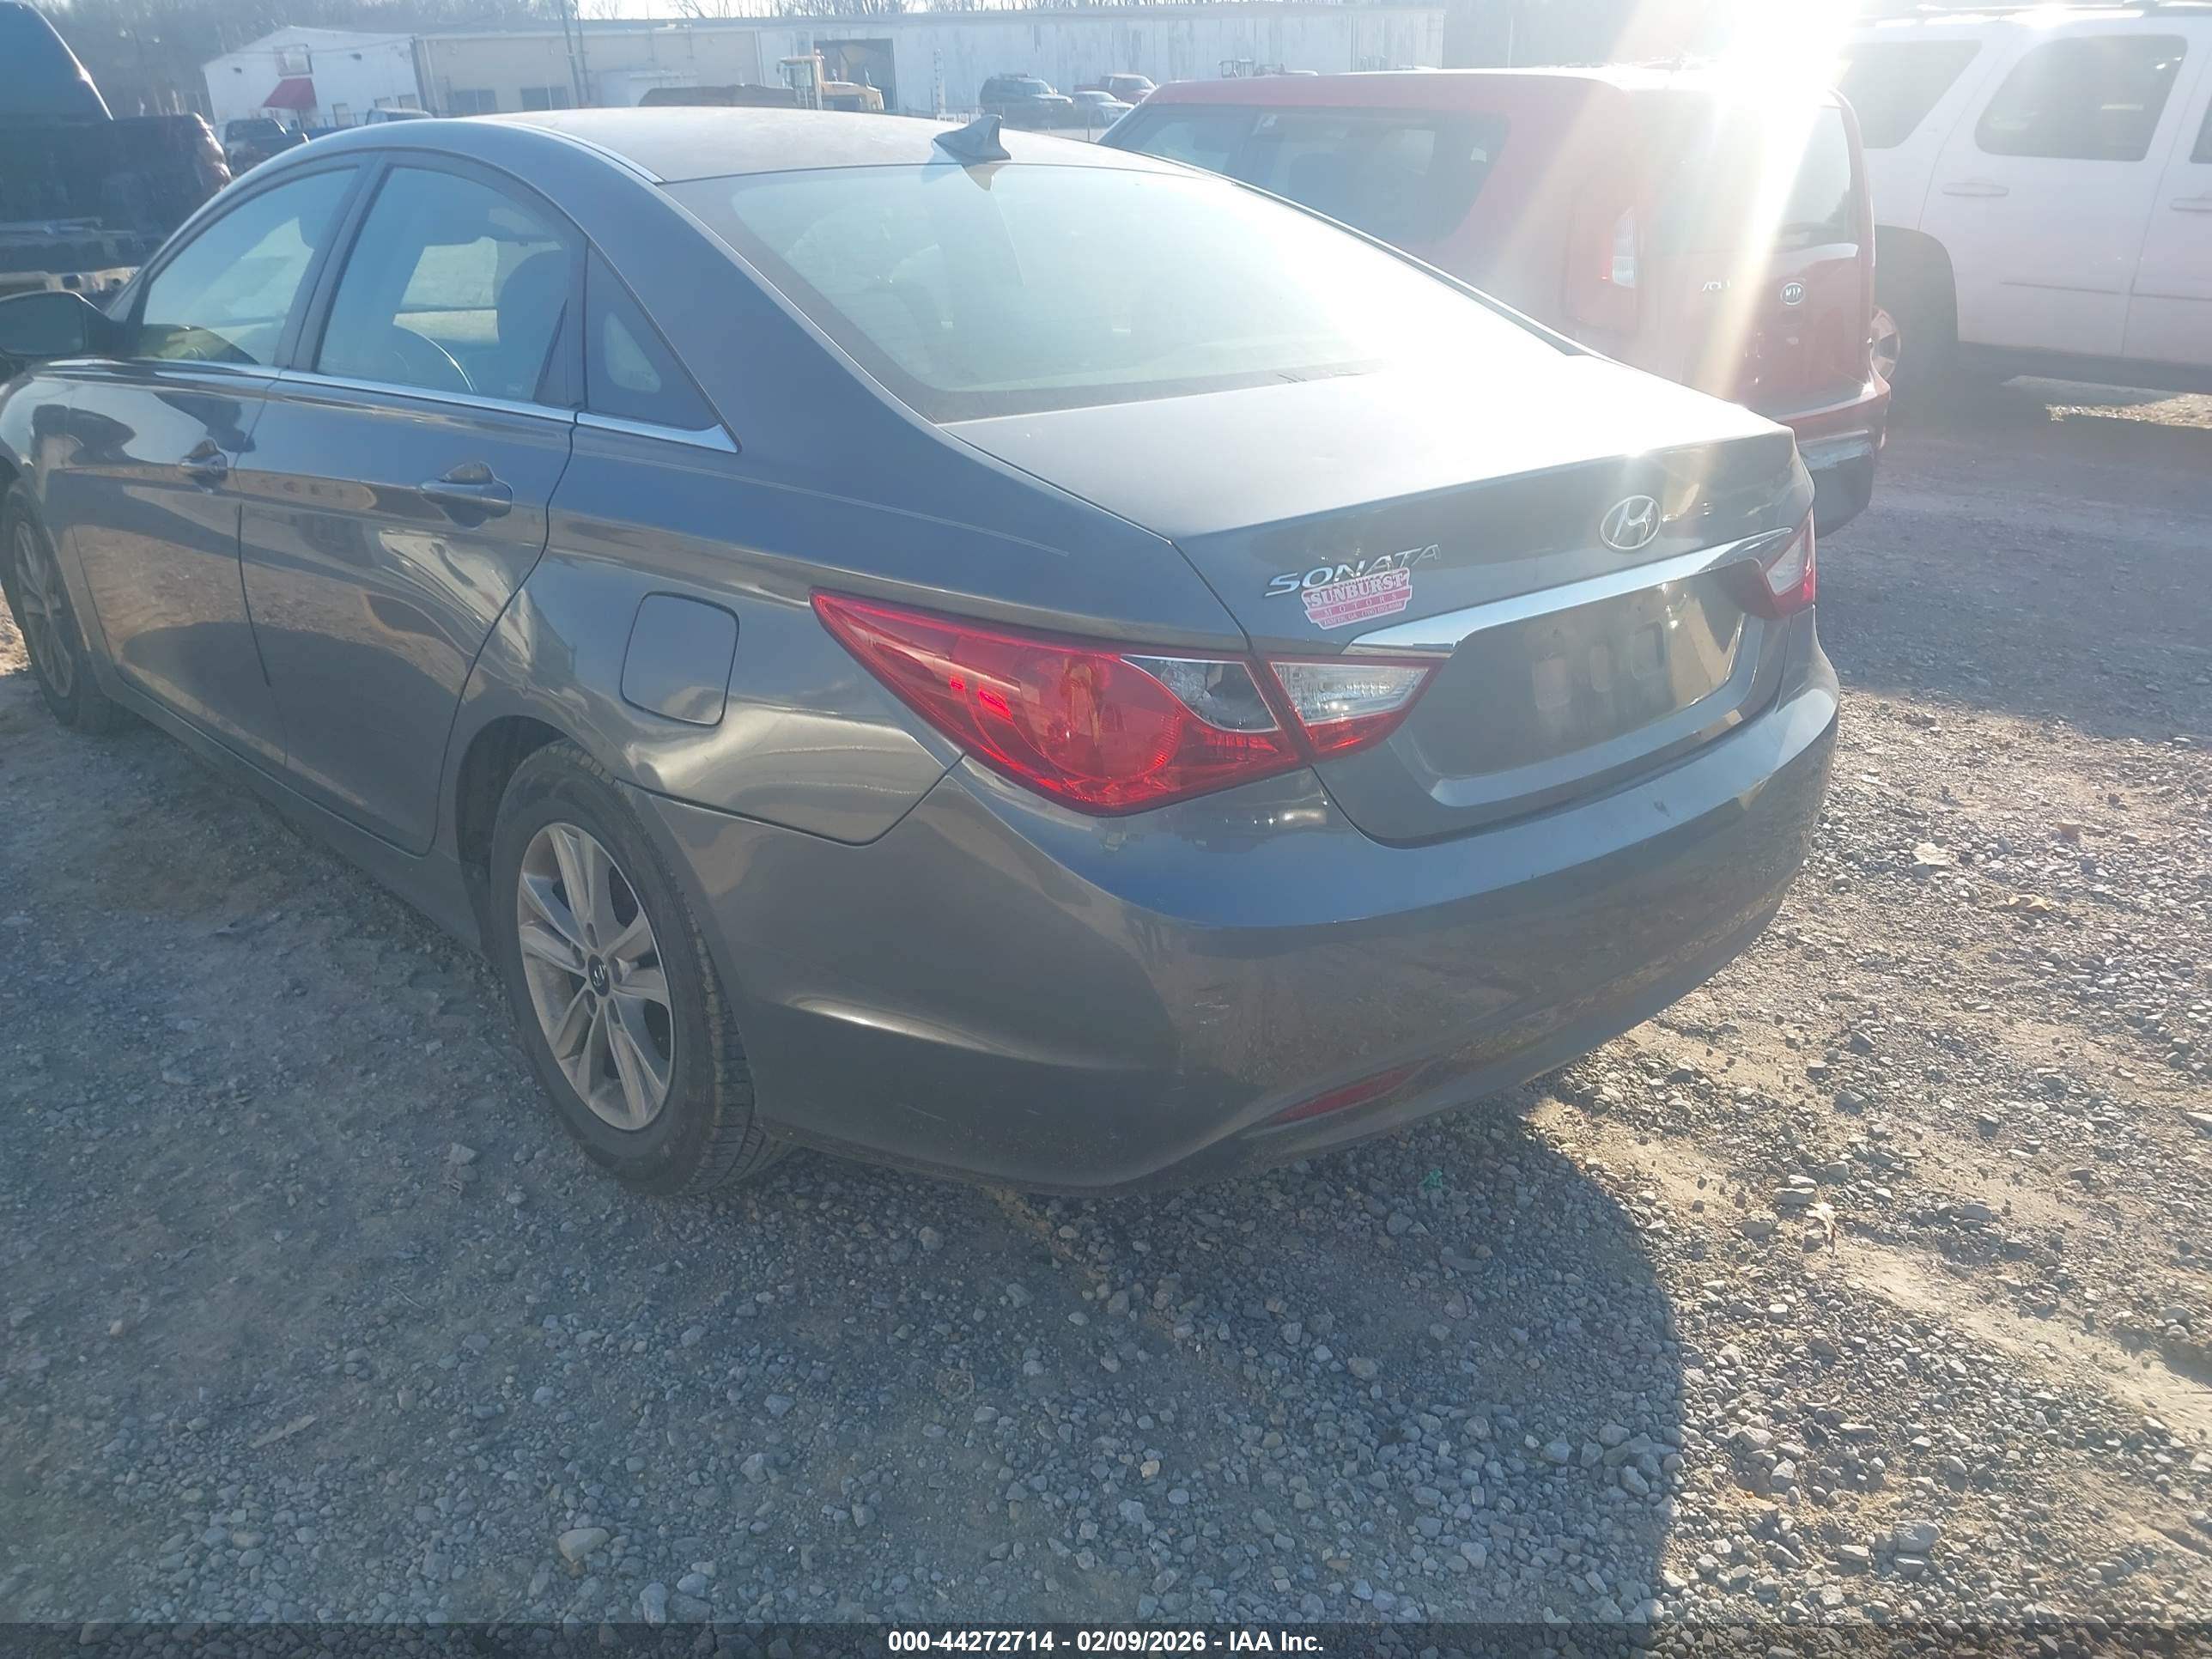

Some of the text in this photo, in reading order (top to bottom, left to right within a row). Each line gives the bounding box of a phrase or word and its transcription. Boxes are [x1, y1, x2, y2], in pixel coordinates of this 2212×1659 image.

[1264, 544, 1442, 598] SONATA
[1310, 573, 1404, 607] SUNBURST
[1324, 593, 1397, 617] MOTORS
